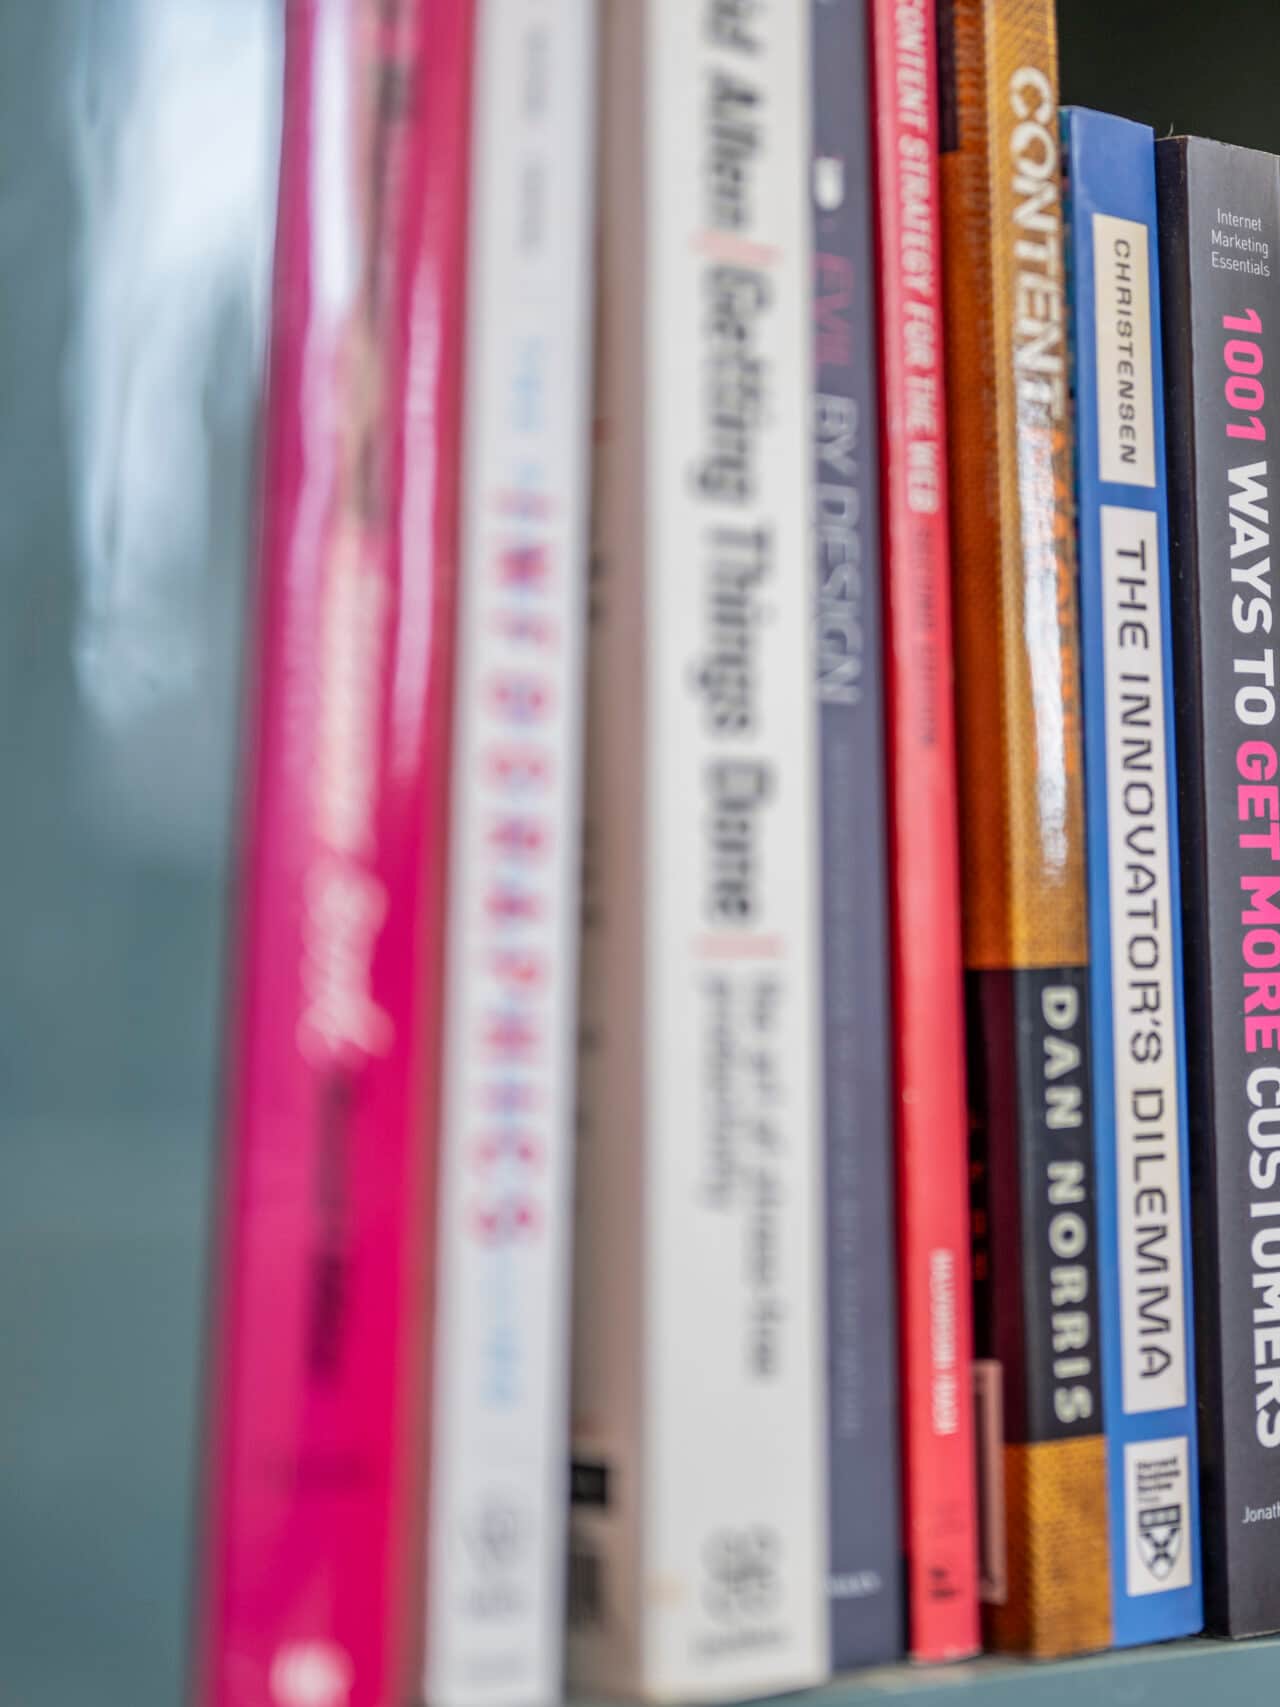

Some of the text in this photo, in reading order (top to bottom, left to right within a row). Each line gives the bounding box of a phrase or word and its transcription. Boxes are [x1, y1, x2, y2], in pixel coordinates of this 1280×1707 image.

[898, 134, 934, 296] STRATEGY
[1010, 66, 1064, 418] CONTENT
[1211, 228, 1269, 259] Marketing
[1211, 251, 1270, 277] Essentials
[1217, 207, 1262, 232] Internet
[903, 301, 937, 368] FOR
[1114, 238, 1137, 464] CHRISTENSEN
[1222, 307, 1266, 441] 1001
[815, 392, 861, 479] BY
[904, 375, 938, 434] THE
[907, 441, 940, 514] WEB
[816, 482, 863, 706] DESIGN
[1227, 460, 1273, 635] WAYS
[1233, 648, 1276, 727] TO
[705, 760, 780, 924] Done
[1236, 740, 1280, 861] GET
[1116, 540, 1172, 1380] THE INNOVATOR'S DILEMMA
[1041, 984, 1092, 1425] DAN NORRIS
